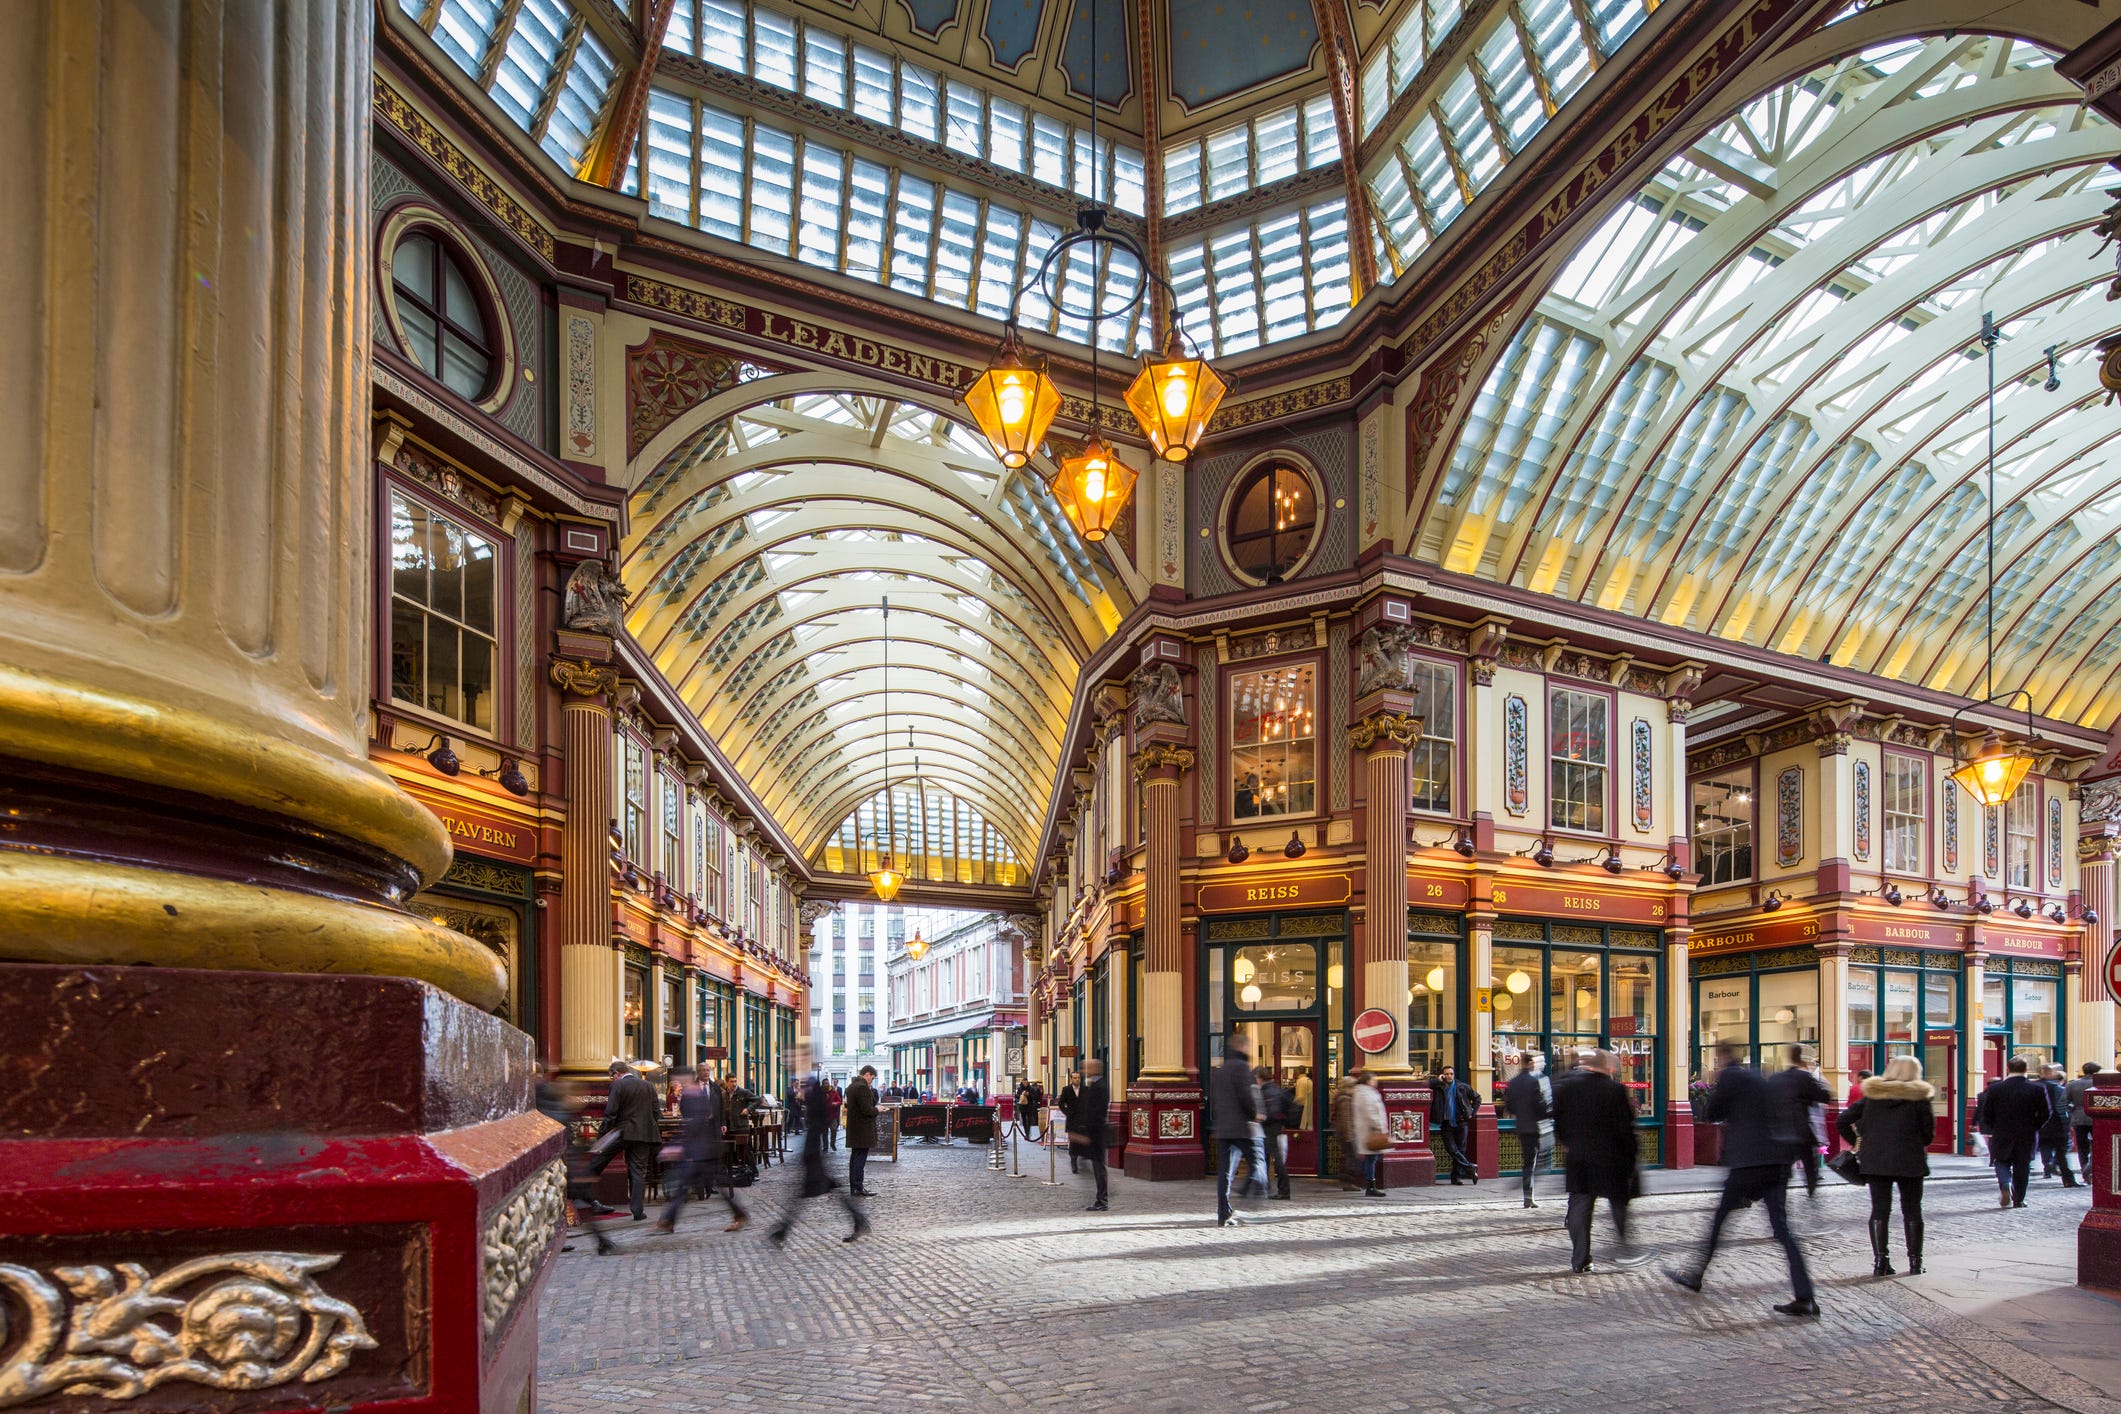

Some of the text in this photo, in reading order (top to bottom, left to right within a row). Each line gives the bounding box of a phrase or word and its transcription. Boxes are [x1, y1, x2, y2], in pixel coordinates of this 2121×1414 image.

[1540, 0, 1771, 239] MARKET
[761, 312, 980, 390] LEADENHA
[442, 815, 517, 848] TAVERN
[1247, 885, 1299, 901] REISS
[1427, 884, 1443, 897] 26
[1493, 890, 1664, 916] 26 REISS 26
[1688, 925, 1816, 950] BARBOUR 31
[1885, 926, 1930, 940] BARBOUR
[1955, 932, 1963, 943] 31
[2004, 937, 2043, 950] BARBOUR
[1708, 990, 1740, 999] Barbour
[1848, 982, 1871, 991] Barbour
[1889, 984, 1911, 993] Barbour
[2024, 993, 2043, 1001] Barbour
[1611, 1021, 1635, 1032] REISS
[1490, 1036, 1536, 1054] SALE
[1609, 1039, 1651, 1055] SALE
